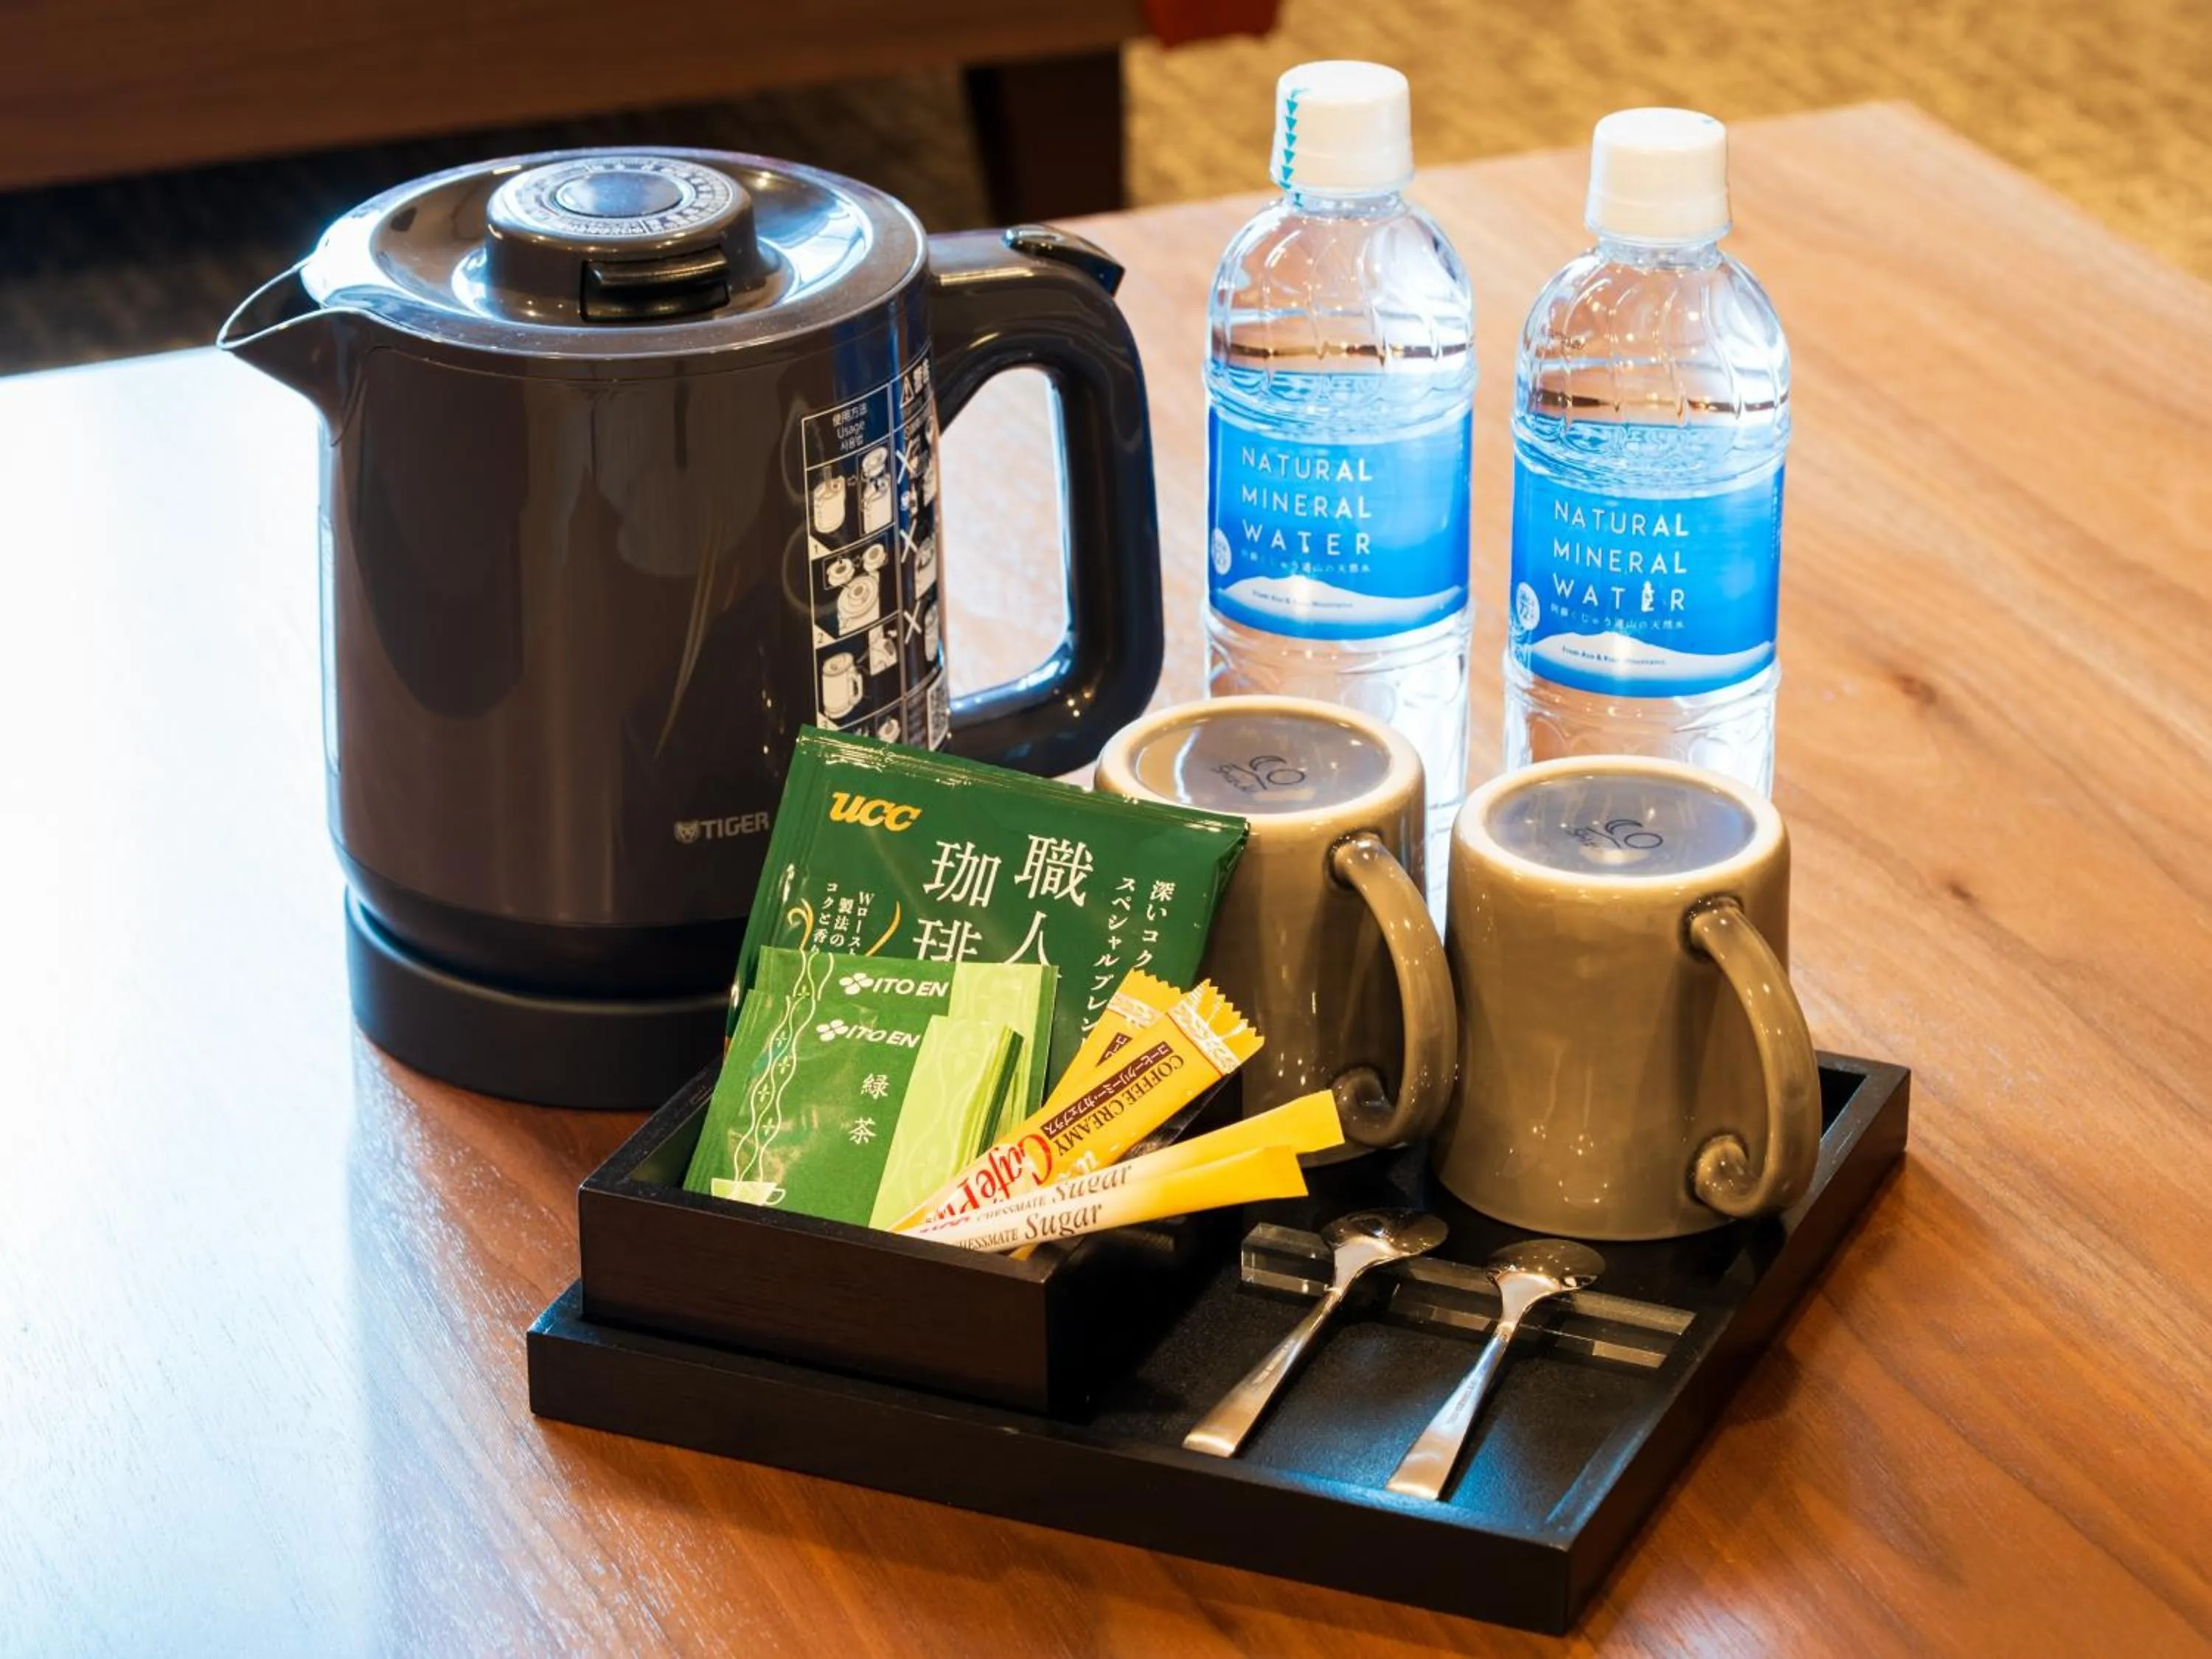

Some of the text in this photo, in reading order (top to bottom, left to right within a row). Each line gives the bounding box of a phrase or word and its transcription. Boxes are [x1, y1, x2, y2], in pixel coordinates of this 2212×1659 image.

[1242, 448, 1372, 481] NATURAL
[1242, 484, 1371, 518] MINERAL
[1554, 499, 1688, 537] NATURAL
[1242, 519, 1371, 554] WATER
[1554, 538, 1687, 575] MINERAL
[1553, 573, 1685, 612] WATER
[700, 812, 769, 840] TIGER
[912, 840, 1002, 961] 珈琲
[1004, 834, 1093, 977] 職人
[830, 897, 854, 947] 製法の
[1133, 879, 1176, 968] 深いコク
[1081, 877, 1137, 1044] スペシャルブレン
[872, 977, 949, 998] ITO EN
[845, 1026, 921, 1048] ITO EN
[849, 1073, 889, 1144] 緑茶
[1054, 1054, 1185, 1156] COFFEE CREAMY
[1052, 1165, 1132, 1203] Sugar
[1025, 1203, 1102, 1239] Sugar
